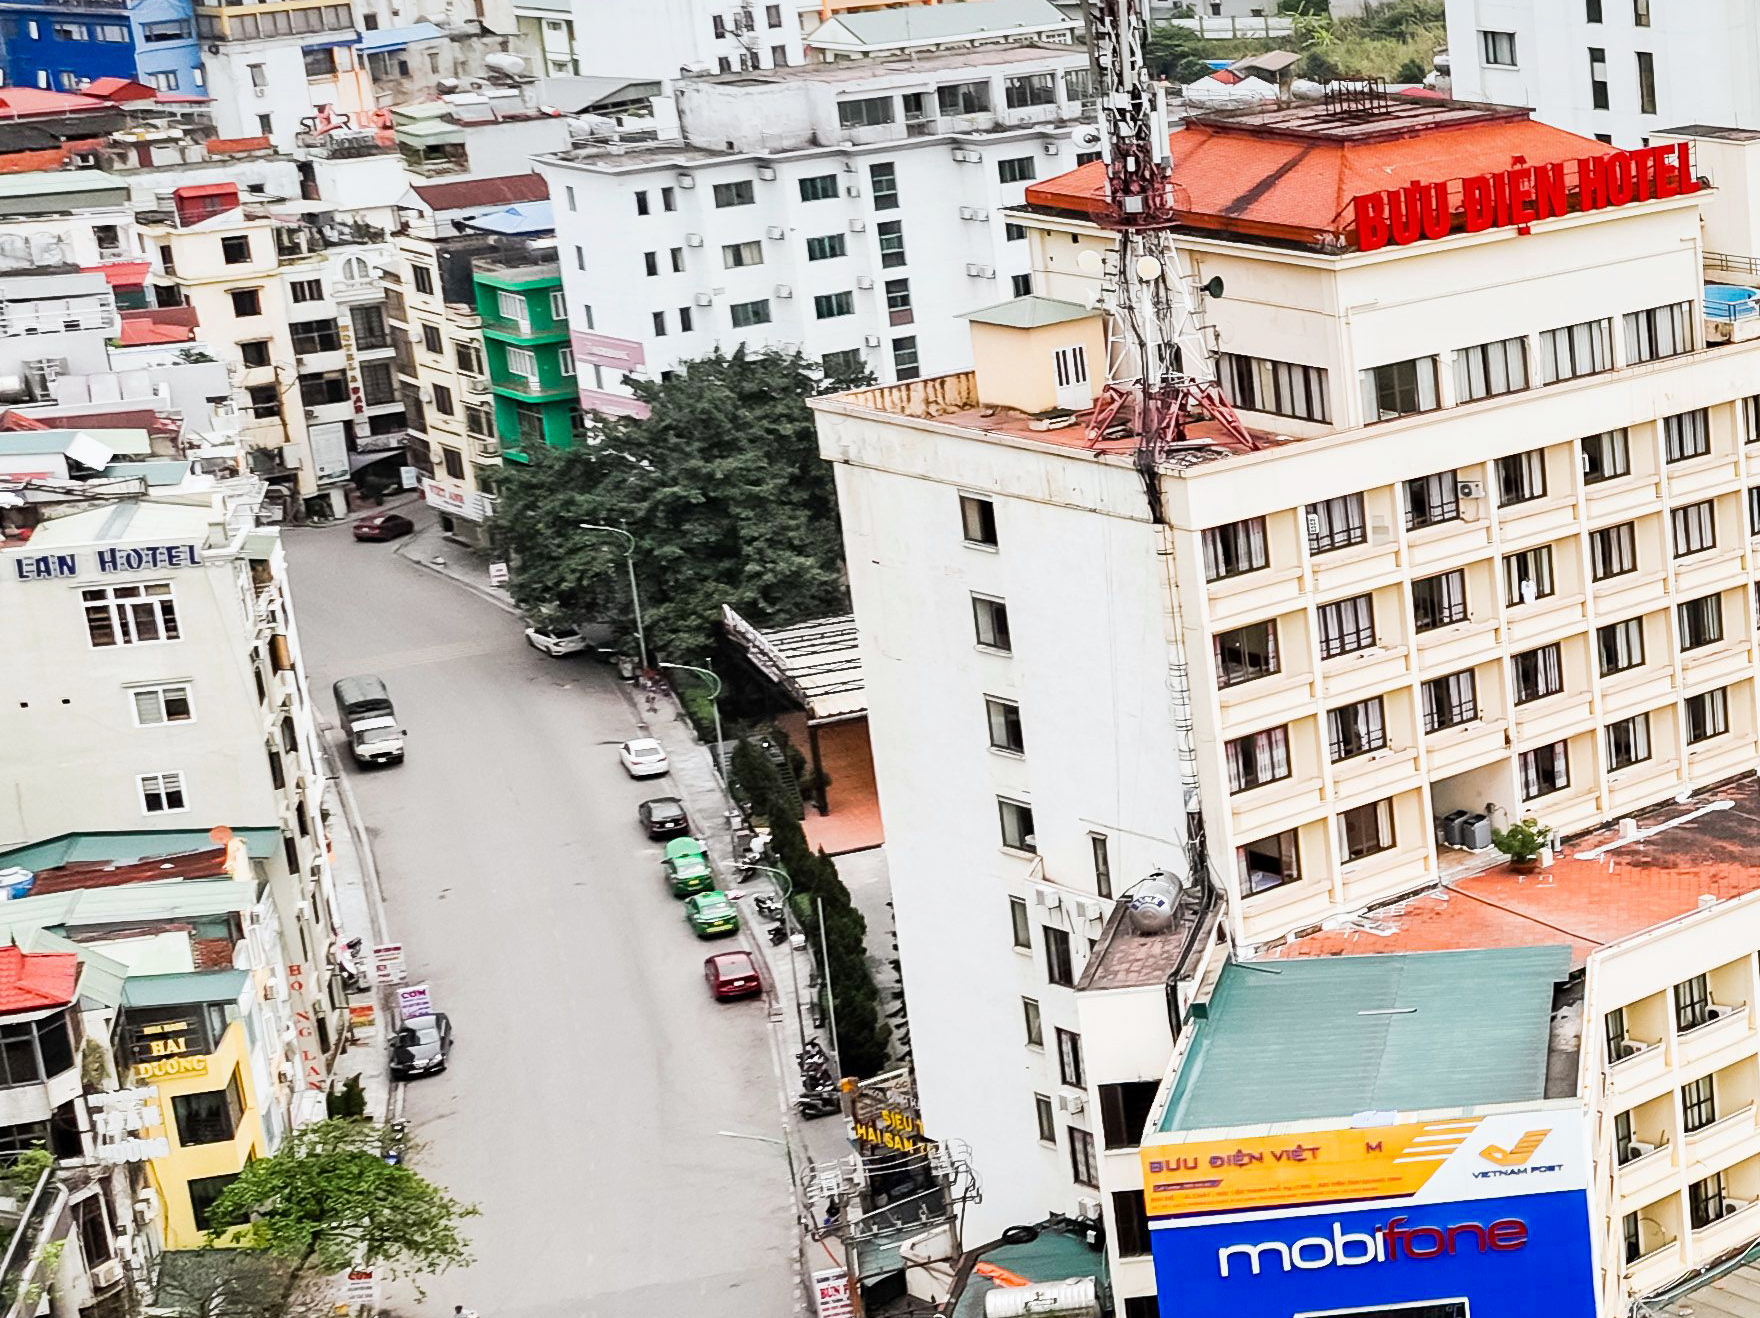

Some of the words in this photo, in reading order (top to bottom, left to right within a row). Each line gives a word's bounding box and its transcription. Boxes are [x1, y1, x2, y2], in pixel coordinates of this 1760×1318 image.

[1354, 180, 1450, 251] BƯU
[1579, 140, 1700, 211] HOTEL
[16, 554, 77, 579] LAN
[98, 544, 201, 573] HOTEL
[1472, 1168, 1527, 1179] VIETNAM
[1530, 1164, 1564, 1174] POST
[1218, 1215, 1529, 1278] mobifone
